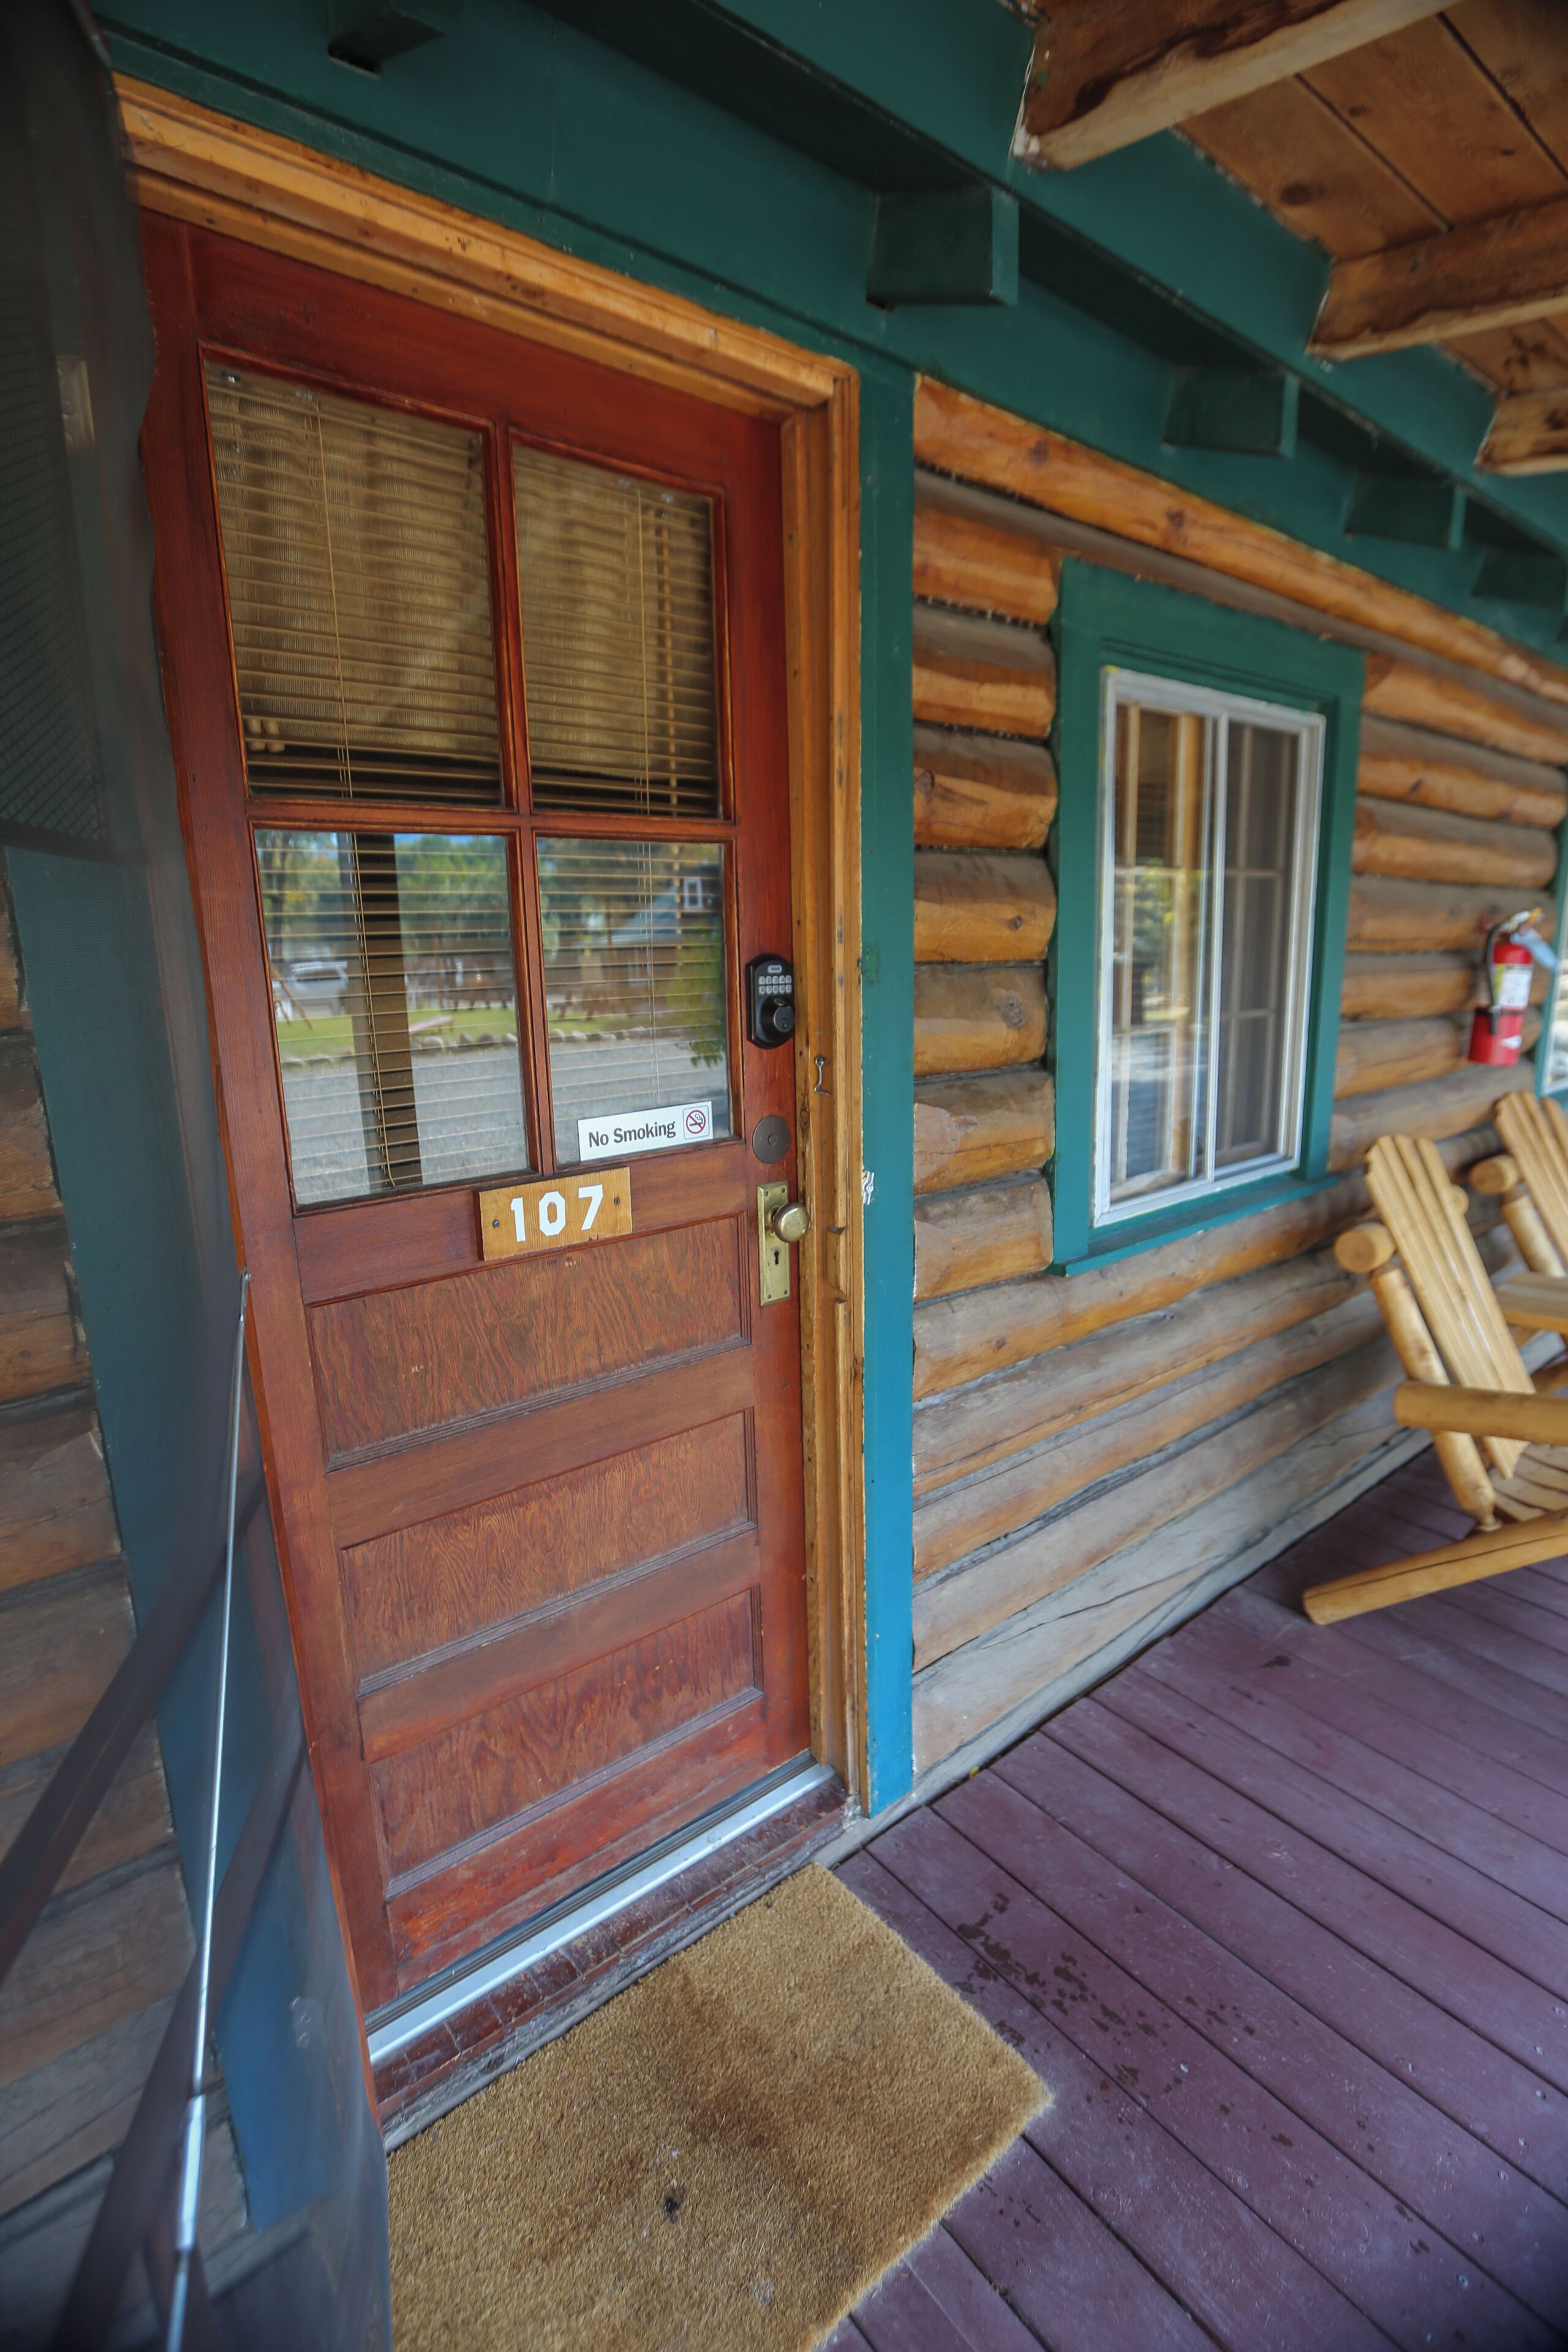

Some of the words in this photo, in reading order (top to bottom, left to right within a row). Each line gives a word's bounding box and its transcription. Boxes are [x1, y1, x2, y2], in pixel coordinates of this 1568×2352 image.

[589, 1131, 609, 1148] No
[613, 1121, 676, 1143] Smoking
[510, 1184, 603, 1242] 107
